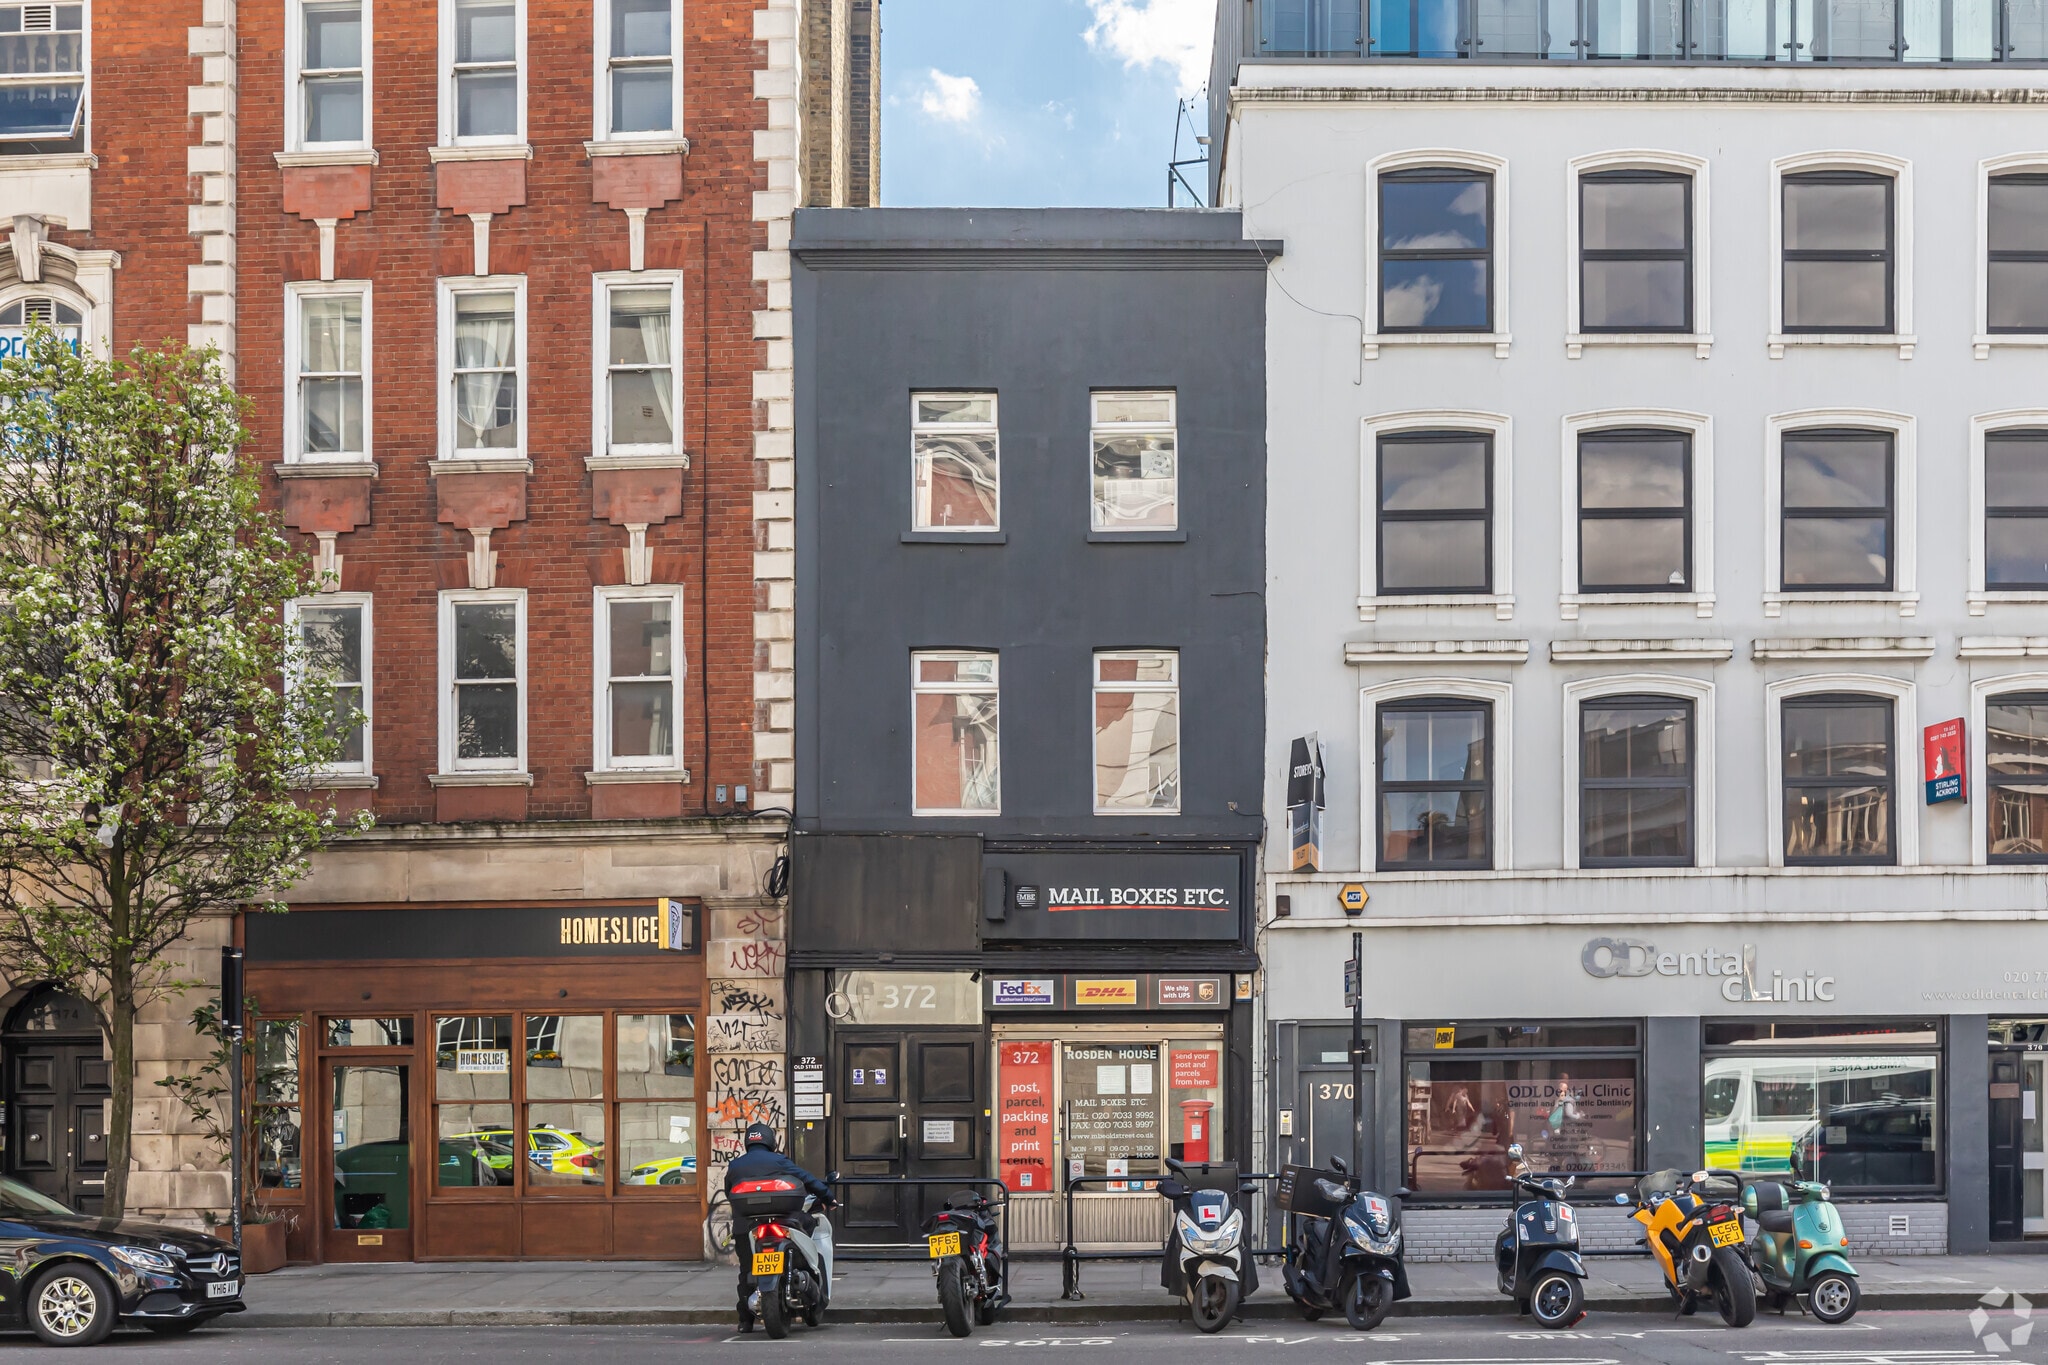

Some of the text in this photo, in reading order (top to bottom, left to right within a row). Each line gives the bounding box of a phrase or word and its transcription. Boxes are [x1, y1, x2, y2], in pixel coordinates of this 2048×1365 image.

[1935, 779, 1958, 790] STIRLING
[1936, 786, 1959, 797] ACKROYD
[1048, 887, 1230, 905] MAIL BOXES ETC.
[1347, 893, 1361, 901] ADT
[561, 916, 659, 944] HOMESLICE
[2003, 970, 2029, 983] 020
[1000, 981, 1041, 995] FedEx
[1084, 987, 1128, 997] DHL
[1176, 985, 1189, 993] ship
[1201, 988, 1213, 997] ups
[882, 984, 937, 1009] 372
[460, 1052, 504, 1065] HOMESLICE
[801, 1056, 816, 1064] 372
[1013, 1051, 1039, 1064] 372
[1066, 1049, 1157, 1060] ROSDEN HOUSE
[1011, 1082, 1040, 1094] post,
[1319, 1083, 1354, 1100] 370
[1508, 1085, 1542, 1098] ODL
[1592, 1084, 1631, 1097] Clinic
[1006, 1095, 1045, 1109] parcel,
[1075, 1098, 1148, 1107] MAIL BOXES ETC.
[1507, 1100, 1539, 1108] General
[1596, 1099, 1632, 1107] Dentistry
[1002, 1111, 1049, 1124] packing
[1071, 1112, 1089, 1120] TEL:
[1091, 1112, 1110, 1120] 020
[1135, 1111, 1154, 1119] 9992
[1070, 1120, 1154, 1129] FAX: 020 7033 9997
[1014, 1126, 1036, 1136] and
[1011, 1139, 1040, 1153] print
[1006, 1156, 1045, 1165] centre
[1370, 1200, 1383, 1211] L
[1203, 1208, 1216, 1218] L
[1561, 1207, 1571, 1220] L
[1709, 1222, 1739, 1237] LC56
[930, 1234, 959, 1246] PF69
[1717, 1233, 1740, 1244] KEJ
[935, 1245, 956, 1256] VJX
[756, 1253, 780, 1264] LN18
[757, 1263, 779, 1273] RBY
[978, 1339, 1113, 1347] SOLO
[1506, 1332, 1647, 1340] ONLY
